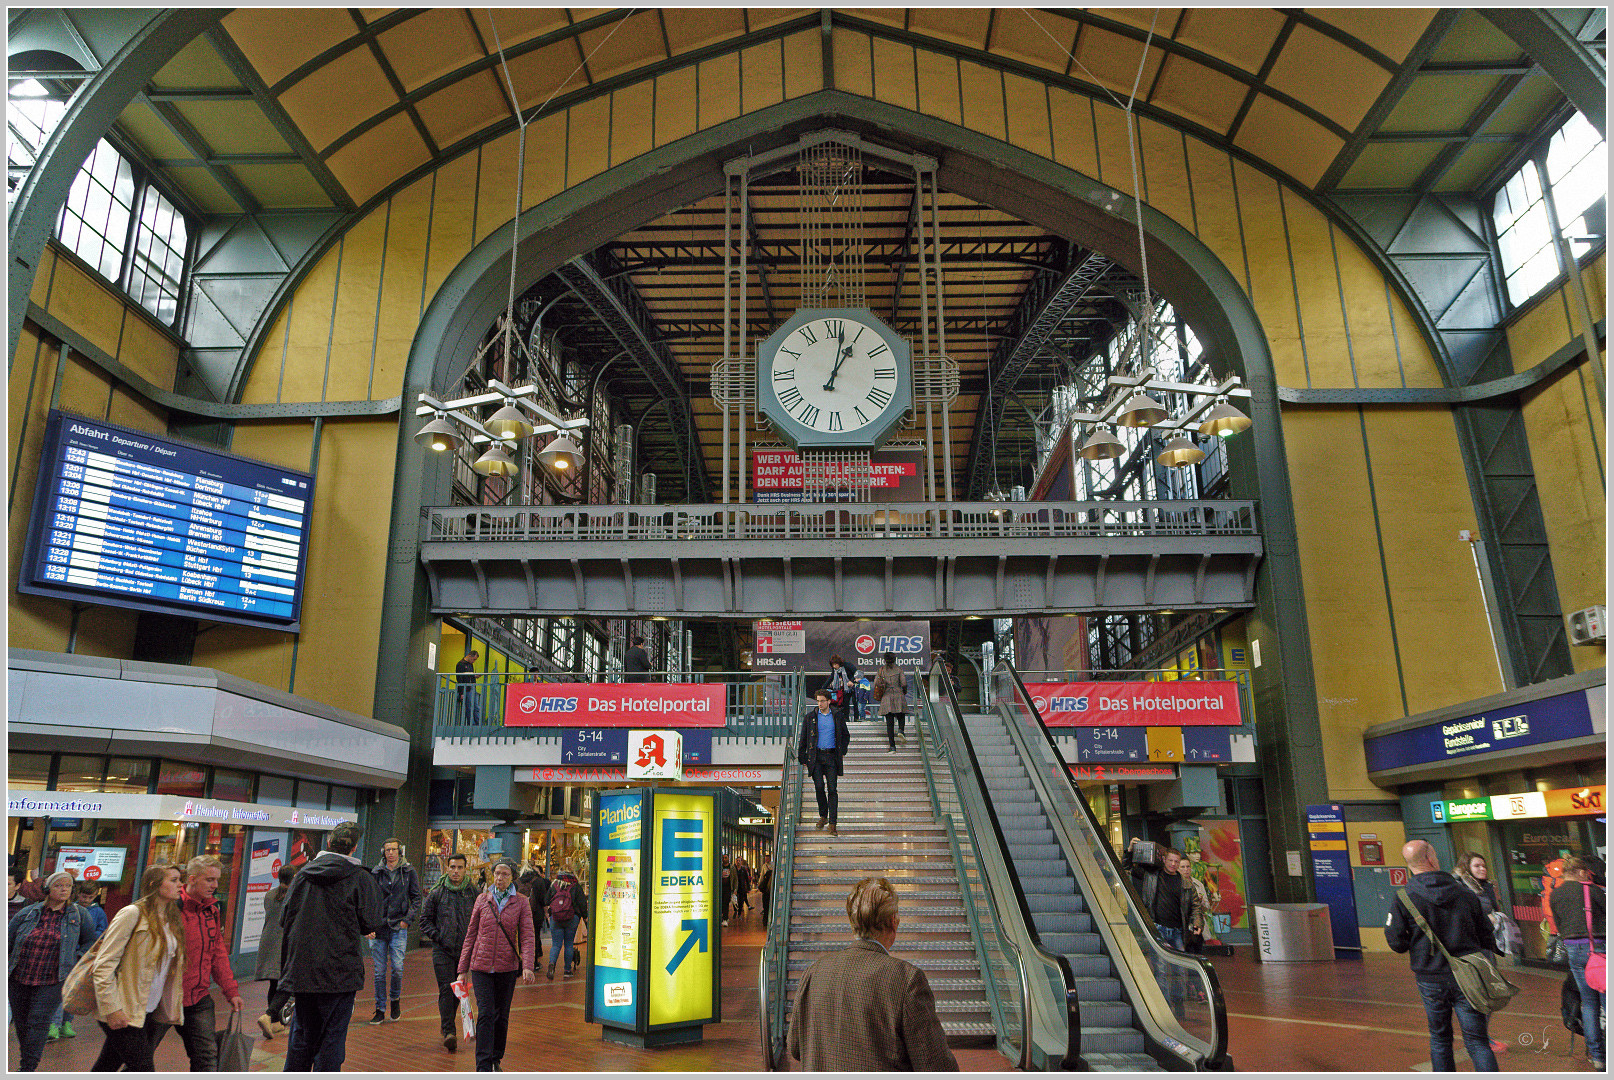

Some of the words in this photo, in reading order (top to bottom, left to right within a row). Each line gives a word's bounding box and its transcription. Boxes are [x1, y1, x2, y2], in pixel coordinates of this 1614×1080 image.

[874, 368, 895, 380] III
[69, 423, 109, 441] Abfahrt
[111, 435, 148, 451] Departure
[154, 445, 176, 457] Départ
[757, 455, 781, 463] WER
[784, 455, 804, 463] VIE
[64, 463, 83, 473] 13:01
[757, 466, 785, 475] DARF
[62, 470, 82, 480] 13:04
[194, 482, 222, 494] Dortmund
[195, 476, 224, 489] Flensburg
[757, 478, 778, 486] DEN
[782, 478, 801, 487] HRS
[193, 491, 219, 502] München
[192, 497, 213, 507] Lübeck
[214, 502, 224, 510] Hbf
[52, 530, 72, 539] 13:21
[187, 528, 211, 539] Bremen
[212, 533, 222, 541] Hbf
[188, 522, 222, 535] Ahrensburg
[51, 537, 71, 546] 13:24
[185, 544, 207, 554] Büchen
[184, 553, 196, 562] Kiel
[197, 556, 208, 564] Hbf
[212, 565, 223, 573] Hbf
[180, 576, 203, 586] Lübeck
[203, 580, 214, 588] Hbf
[179, 586, 203, 595] Bremen
[878, 635, 923, 653] HRS
[756, 658, 787, 666] HRS.de
[858, 658, 877, 666] Das
[539, 697, 578, 713] HRS
[588, 699, 616, 711] Das
[621, 697, 710, 714] Hotelportal
[1050, 697, 1088, 712] HRS
[1100, 697, 1128, 711] Das
[1133, 695, 1224, 712] Hotelportal
[578, 730, 603, 742] 5-14
[1093, 728, 1118, 740] 5-14
[685, 768, 762, 780] Obergeschoss
[1118, 767, 1173, 777] Obergeschoss
[8, 797, 102, 811] nformation
[1449, 802, 1487, 818] Europcar
[661, 876, 704, 886] EDEKA
[1260, 923, 1271, 955] Abfall
